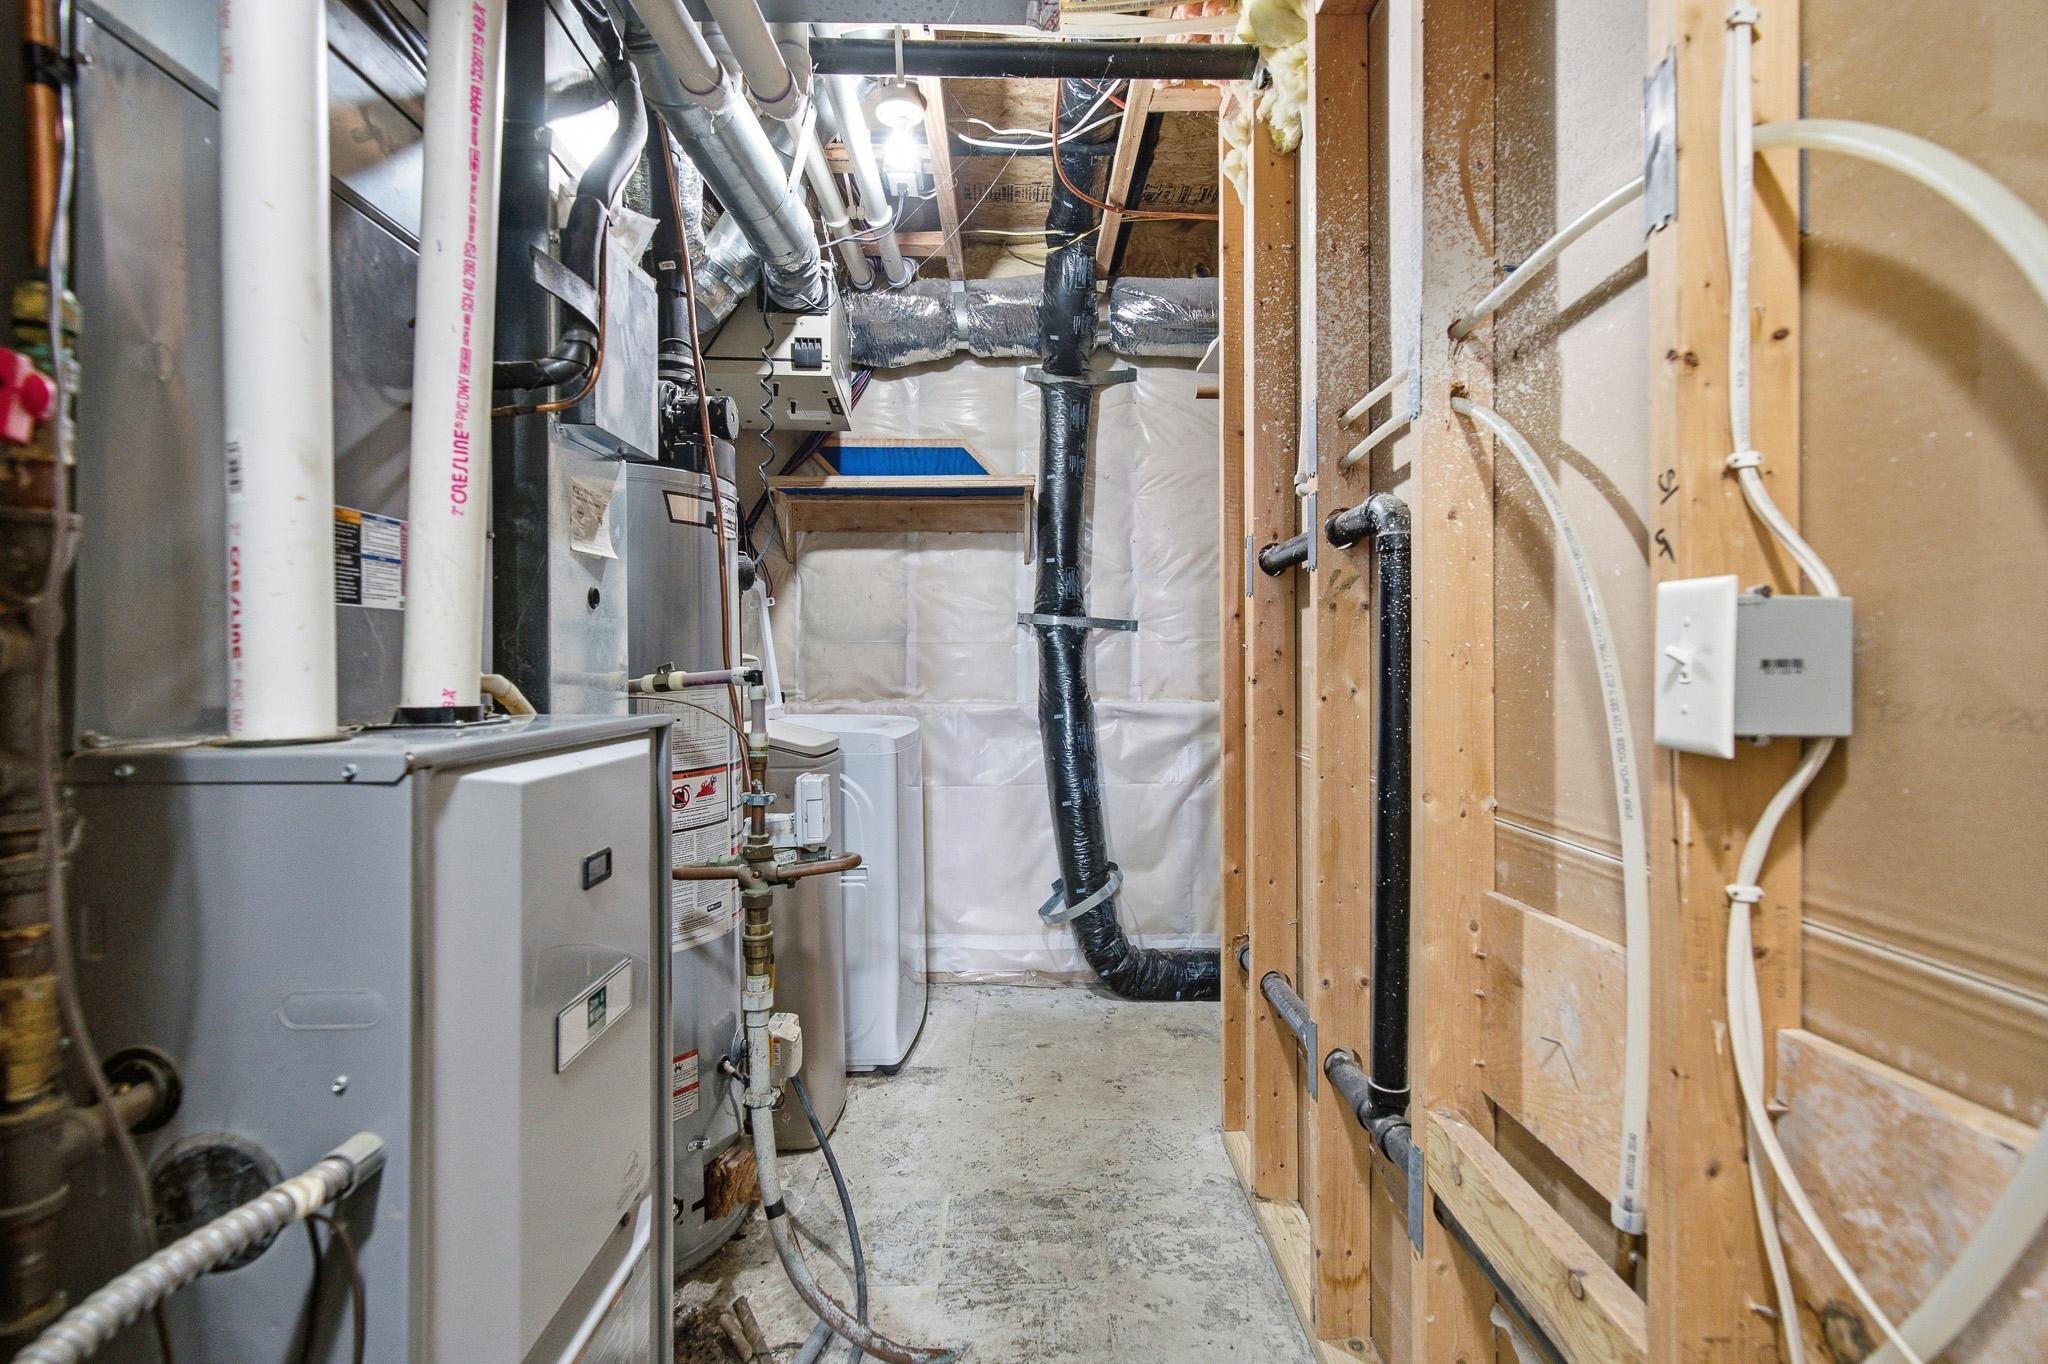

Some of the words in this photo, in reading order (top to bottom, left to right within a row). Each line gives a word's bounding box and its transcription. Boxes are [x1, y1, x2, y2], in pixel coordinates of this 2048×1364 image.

[463, 241, 476, 257] PSI
[463, 279, 475, 294] 40
[461, 293, 474, 314] SCH
[457, 375, 470, 400] DWV
[456, 403, 468, 422] PVC
